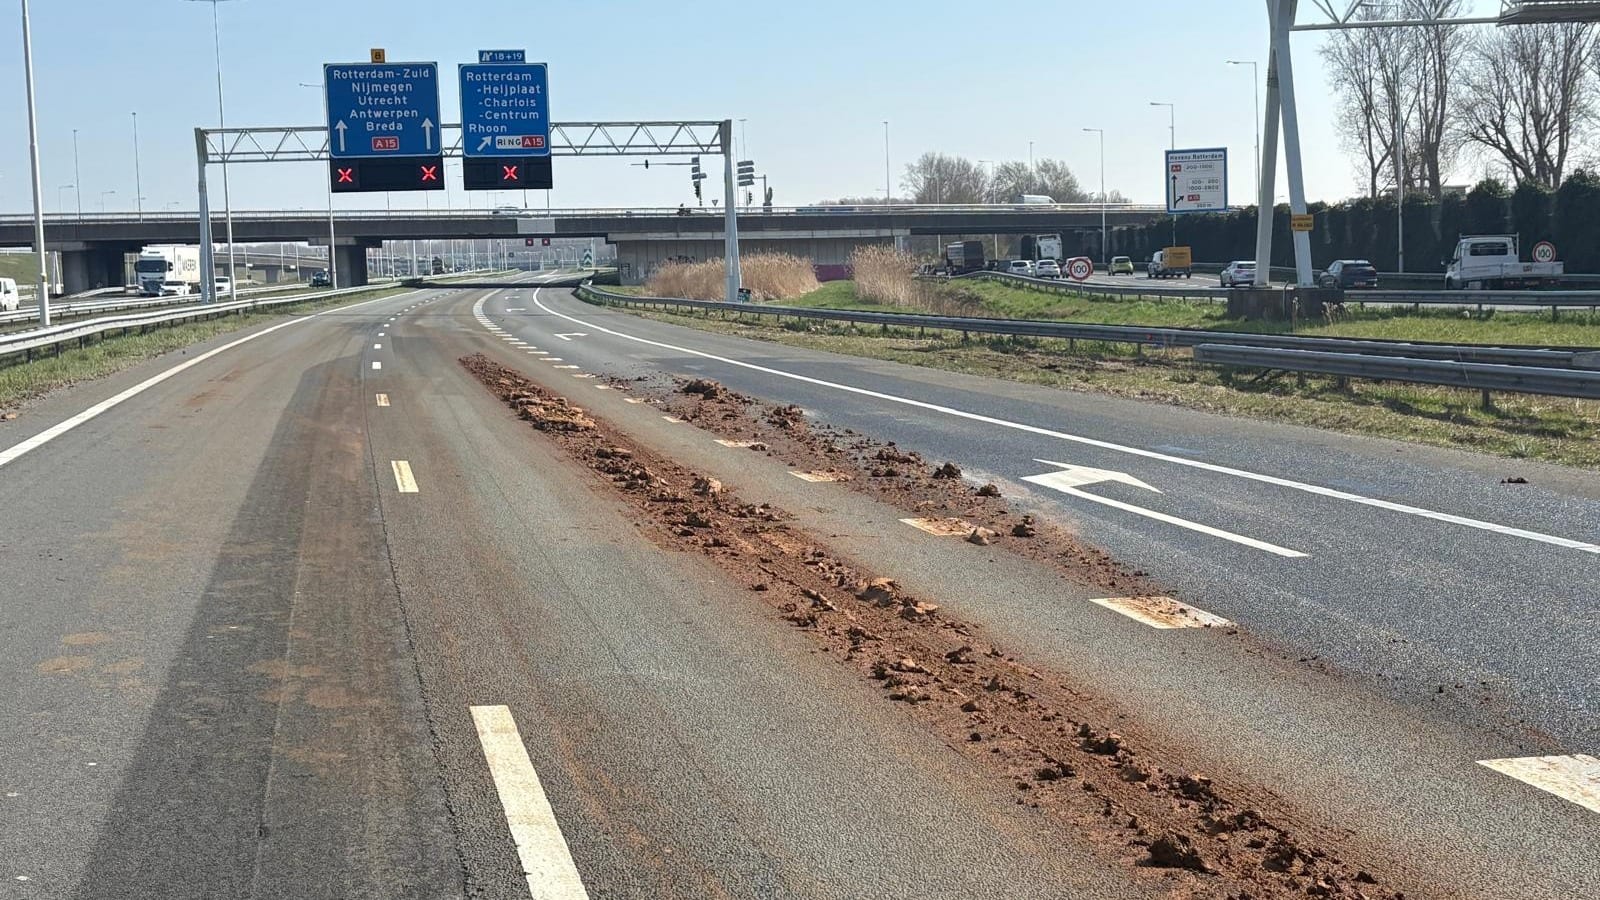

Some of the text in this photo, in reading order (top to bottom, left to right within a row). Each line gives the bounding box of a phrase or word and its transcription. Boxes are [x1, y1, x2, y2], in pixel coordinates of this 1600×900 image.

[333, 69, 429, 80] Rotterdam-Zuid
[466, 72, 532, 81] Rotterdam
[352, 82, 413, 95] Nijmegen
[358, 96, 408, 105] Utrecht
[479, 98, 536, 107] -Charlois
[350, 109, 418, 119] Antwerpen
[480, 110, 539, 120] -Centrum
[366, 121, 403, 131] Breda
[469, 123, 507, 133] Rhoon
[375, 139, 396, 148] A15
[497, 137, 543, 146] RING A15
[1538, 249, 1551, 258] 100
[1073, 265, 1087, 274] 100
